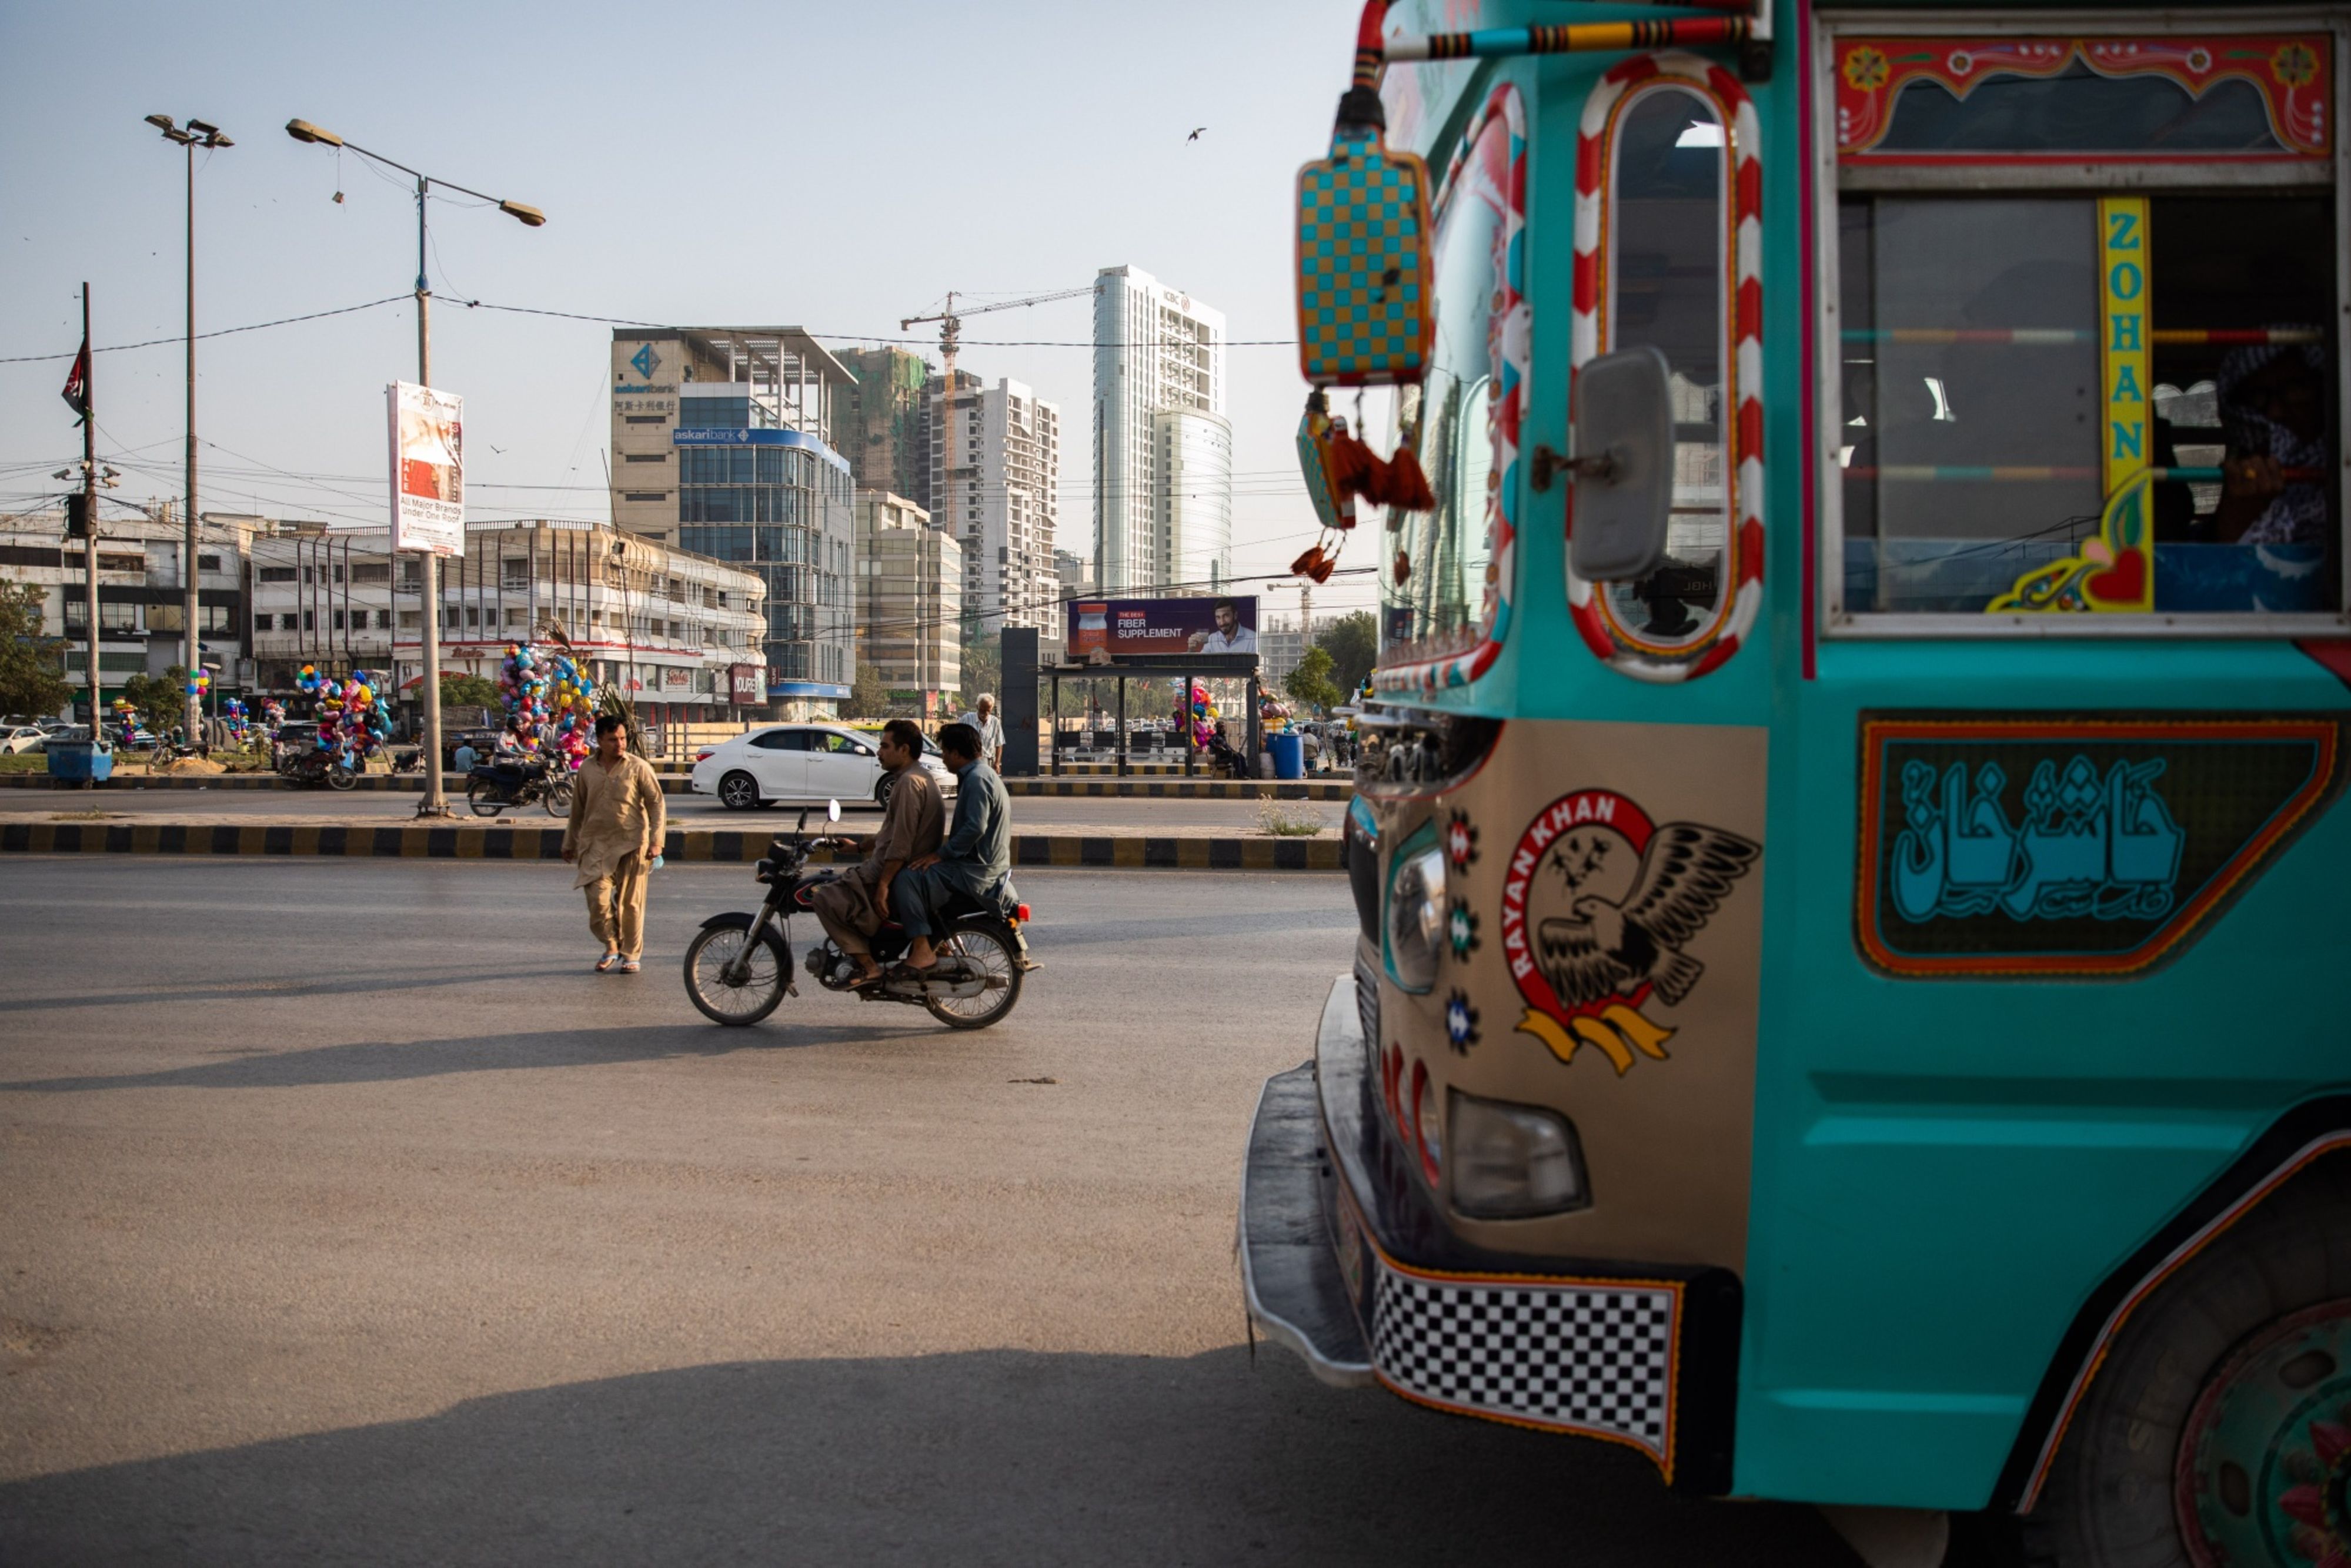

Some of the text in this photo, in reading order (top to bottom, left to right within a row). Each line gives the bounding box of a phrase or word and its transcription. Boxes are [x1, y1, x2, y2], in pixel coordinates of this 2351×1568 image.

[2108, 213, 2143, 459] ZOHAN
[674, 429, 736, 439] askaribank
[400, 497, 462, 515] All Major Brands
[402, 506, 460, 524] Under One Roof
[1118, 618, 1146, 628] FIBER
[1117, 628, 1183, 638] SUPPLEMENT
[1502, 794, 1617, 979] RAYAN KHAN
